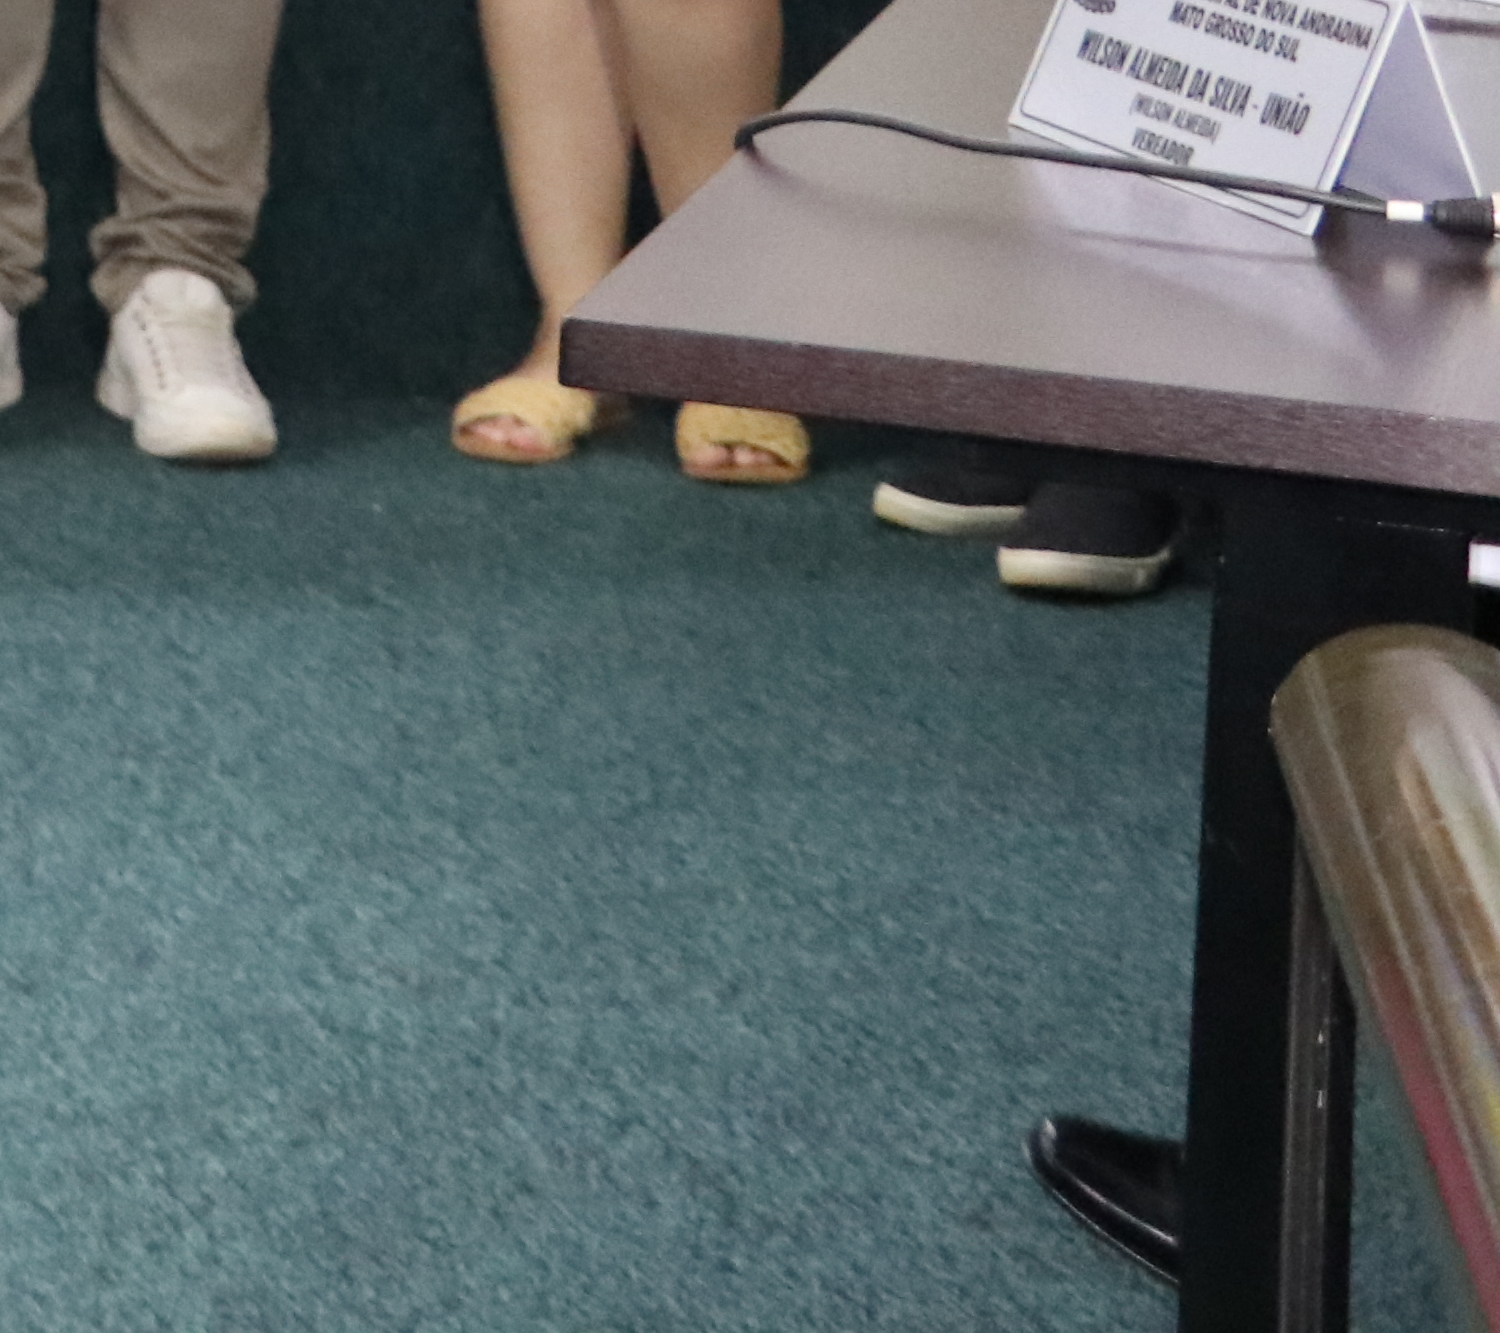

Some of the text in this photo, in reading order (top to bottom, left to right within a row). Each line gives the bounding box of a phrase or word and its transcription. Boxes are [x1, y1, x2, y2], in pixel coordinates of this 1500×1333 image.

[1168, 0, 1301, 64] MATO GROSSO DO SUL
[1297, 7, 1374, 51] ANDRADINA
[1076, 28, 1132, 74] WILSON
[1125, 47, 1191, 100] ALMEIDA
[1186, 68, 1213, 102] DA
[1208, 75, 1254, 118] SILVA
[1259, 91, 1312, 136] UNIÃO
[1131, 126, 1195, 167] VEREADOR
